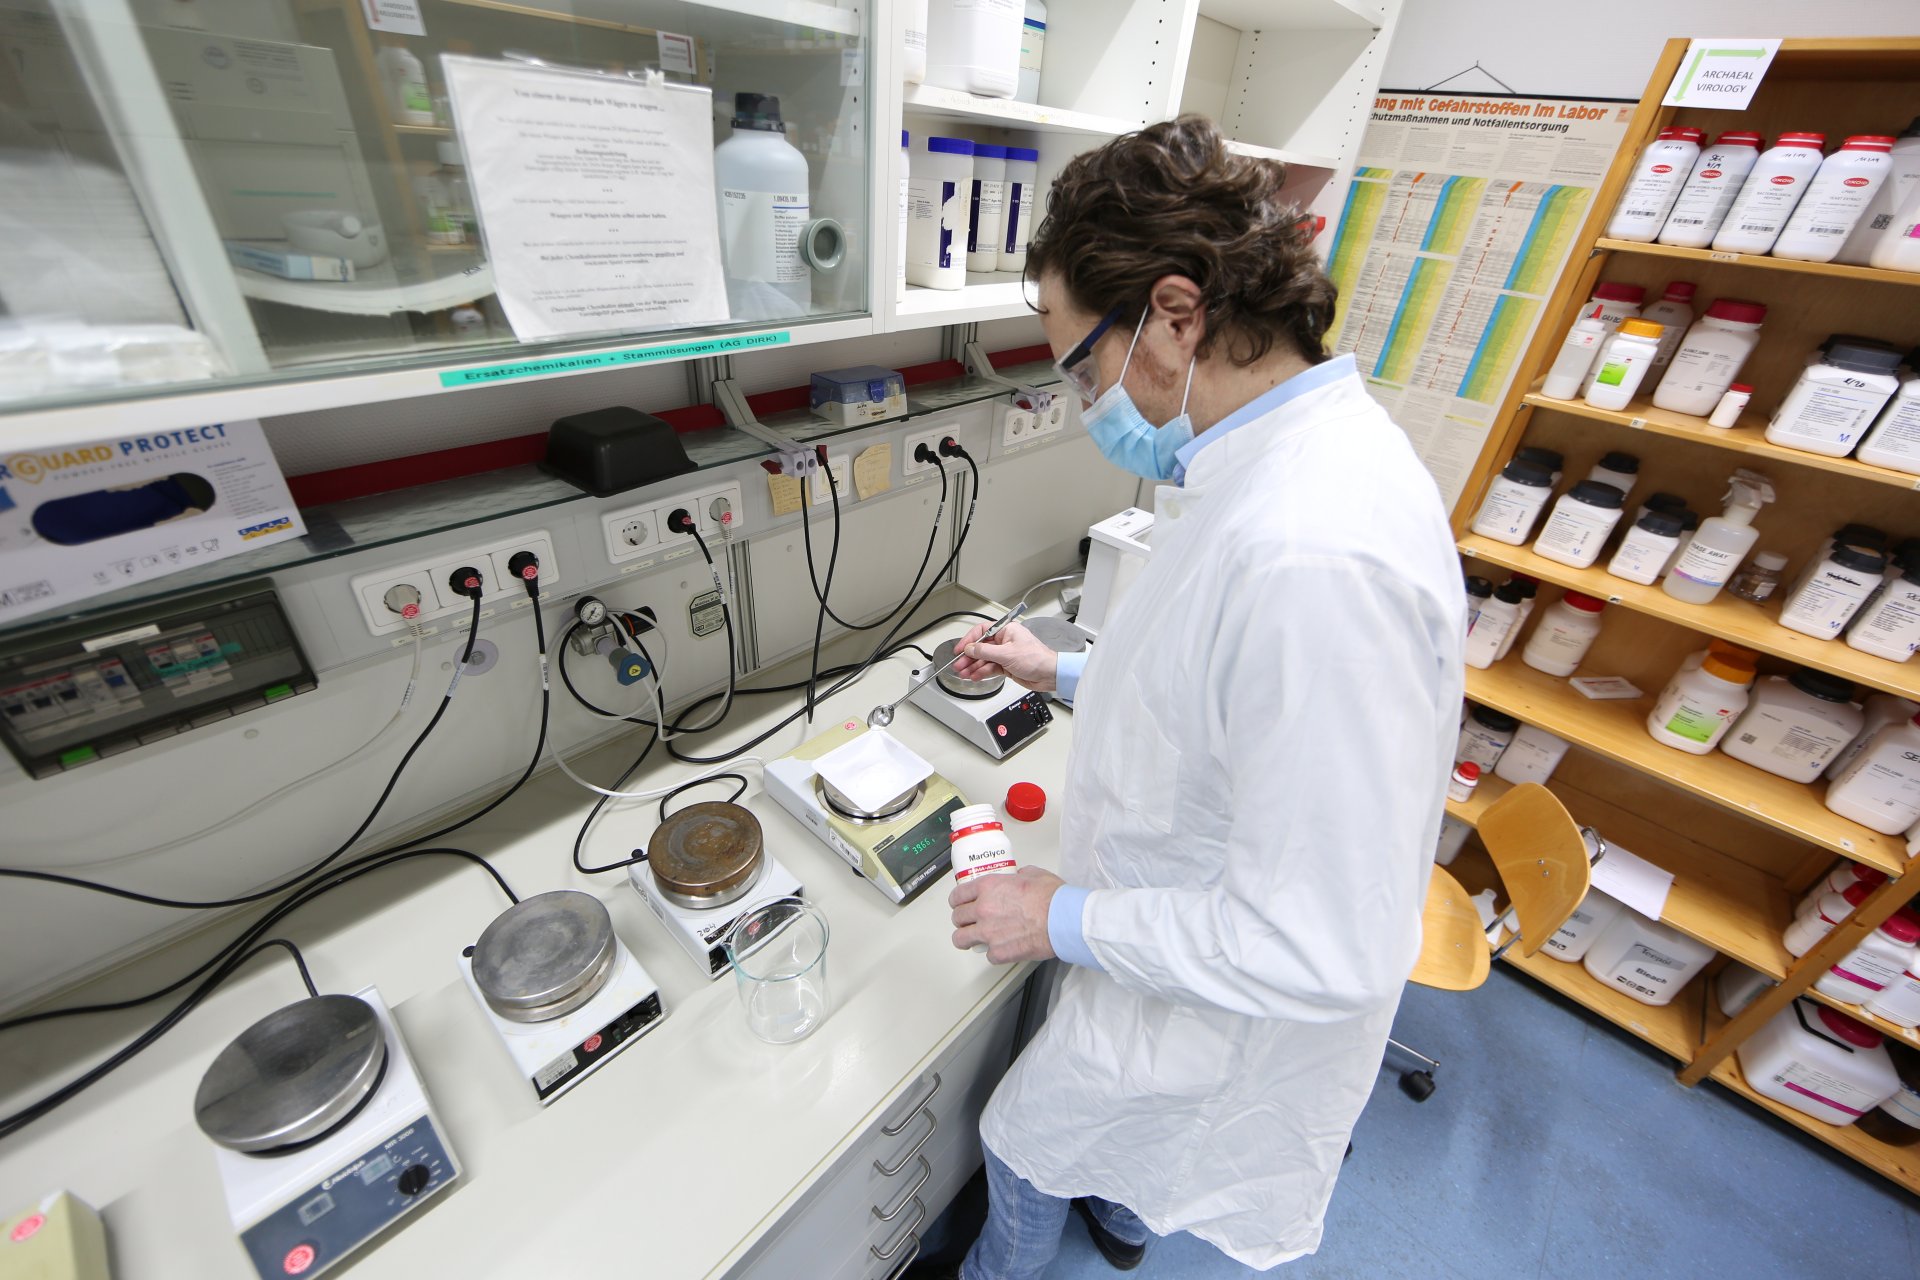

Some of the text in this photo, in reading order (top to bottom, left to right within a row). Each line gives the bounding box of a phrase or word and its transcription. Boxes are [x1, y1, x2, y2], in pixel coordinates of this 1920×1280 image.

[1702, 70, 1754, 80] ARCHAEAL
[1696, 83, 1747, 93] VIROLOGY
[1400, 98, 1423, 112] mit
[1428, 98, 1531, 117] Gefahrstoffen
[1533, 103, 1556, 117] im
[1557, 103, 1608, 121] Labor
[1451, 116, 1471, 126] und
[1472, 117, 1569, 134] Notfallentsorgung
[464, 356, 601, 381] Ersatzchemikalien
[623, 343, 715, 362] Stammlösungen
[719, 339, 741, 350] (AG
[747, 334, 777, 346] DIRK)
[118, 423, 228, 457] PROTECT
[968, 848, 1006, 863] MarGlyco
[968, 861, 1009, 875] SMA-ALDRICH
[1641, 947, 1673, 966] Teepol
[1635, 967, 1668, 985] Bleach
